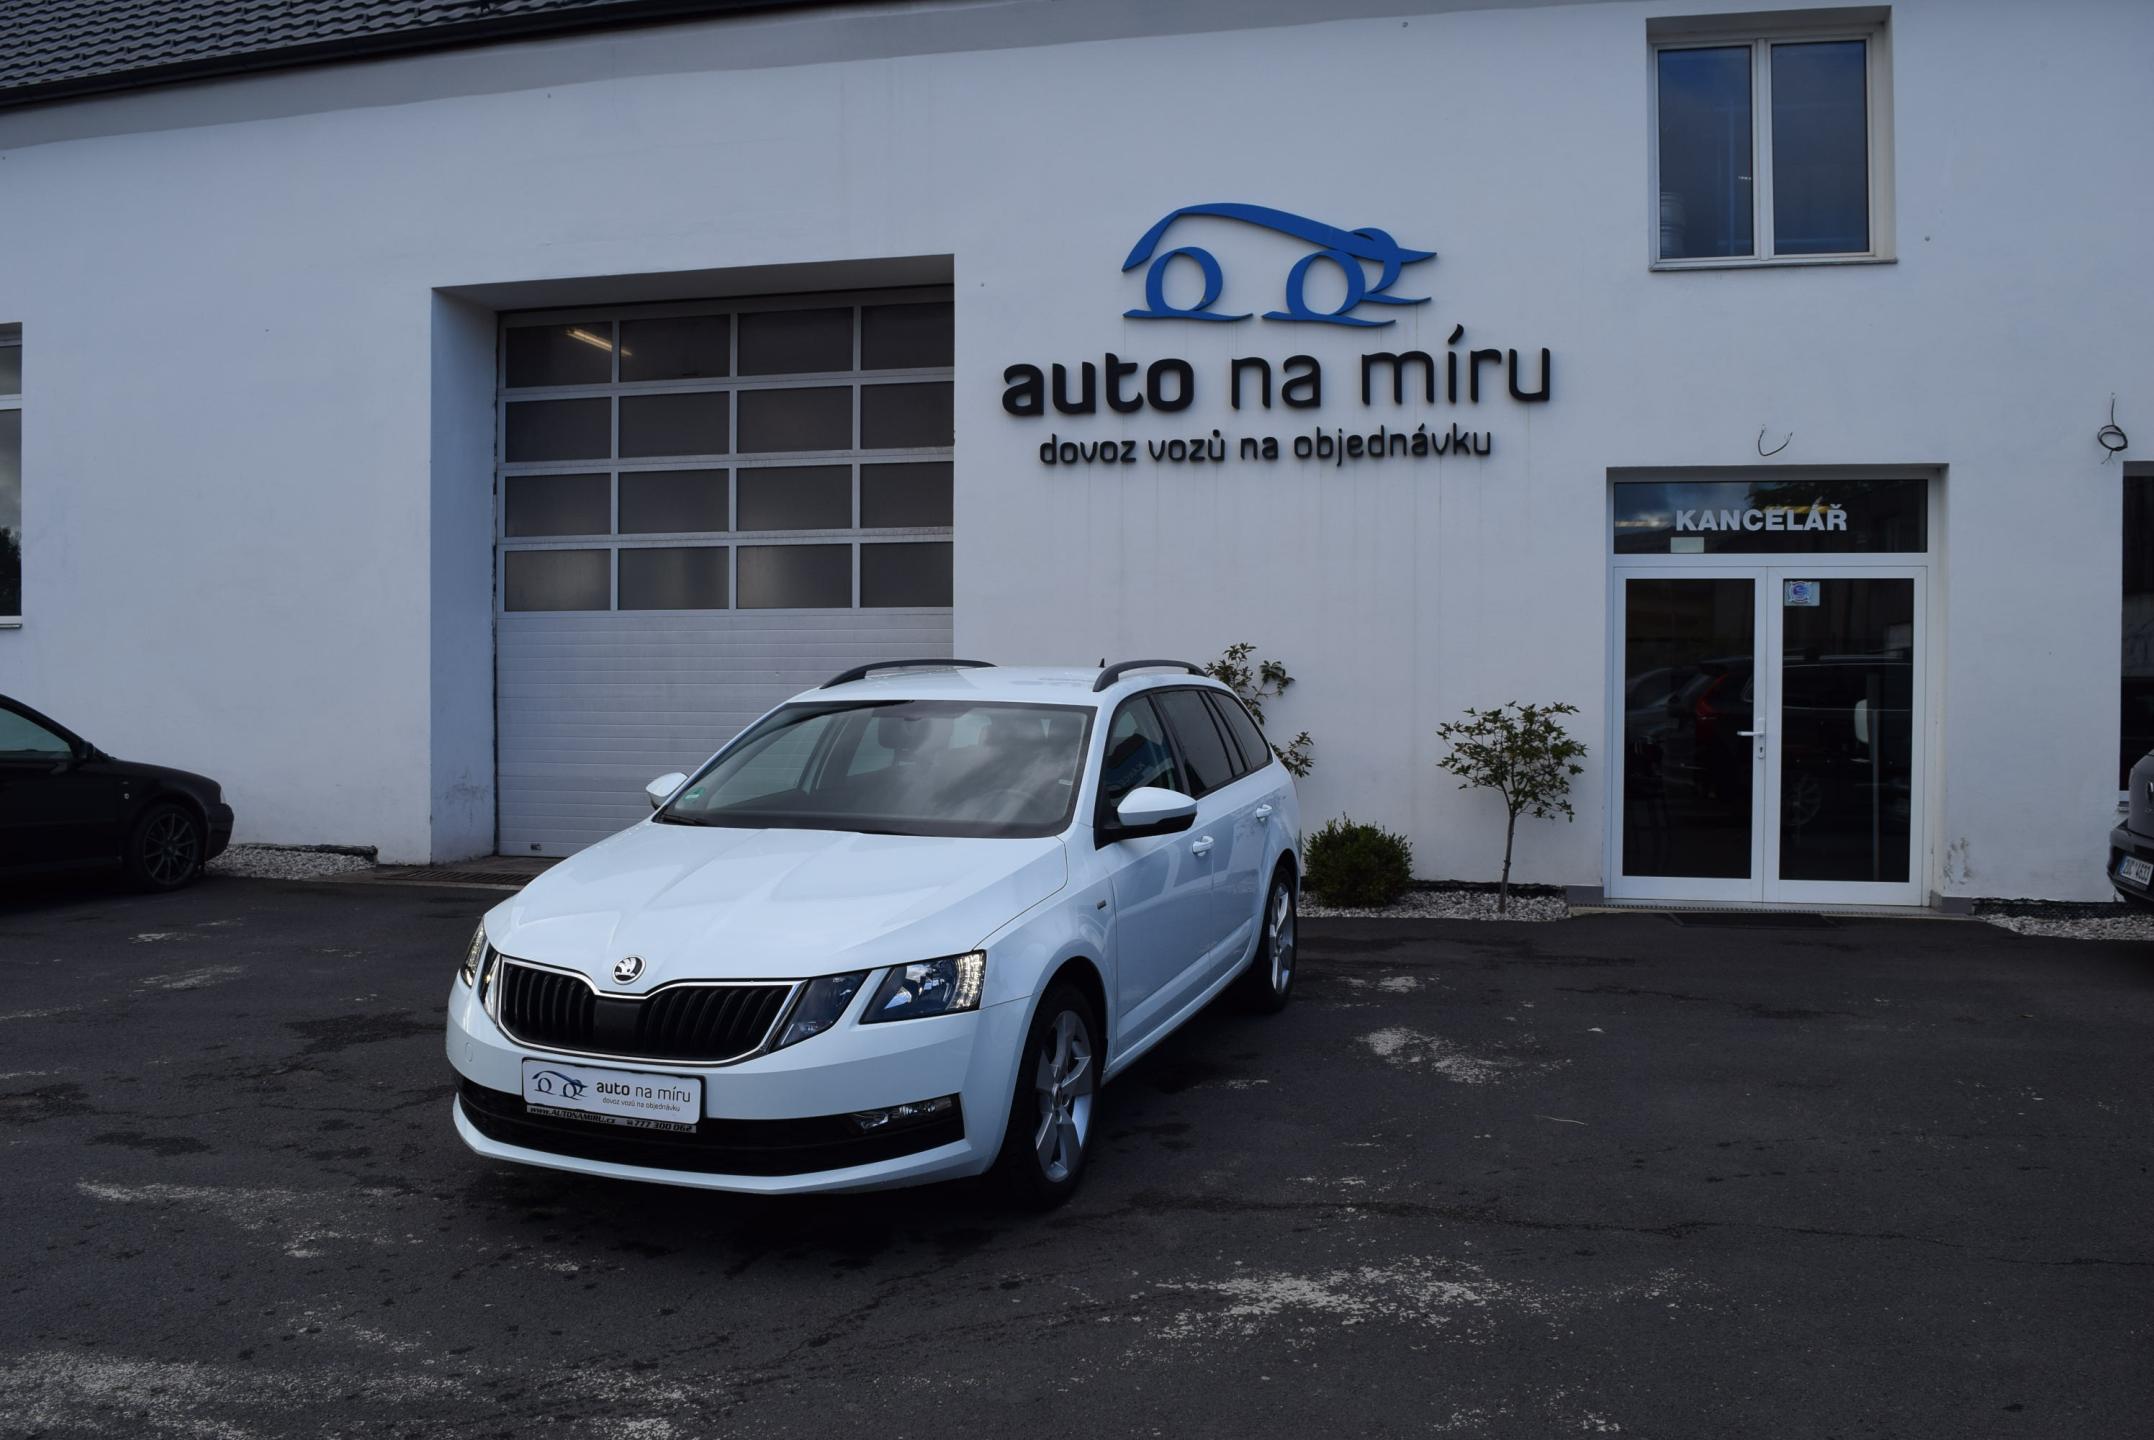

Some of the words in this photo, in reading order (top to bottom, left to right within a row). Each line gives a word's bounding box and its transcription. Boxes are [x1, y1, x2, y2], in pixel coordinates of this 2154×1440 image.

[1001, 352, 1195, 418] auto
[1231, 354, 1322, 411] na
[1361, 323, 1551, 407] míru
[1039, 433, 1137, 467] dovoz
[1147, 429, 1226, 464] vozů
[1240, 436, 1279, 462] na
[1293, 422, 1492, 468] objednávku
[1675, 503, 1848, 531] KANCELÁŘ
[596, 1081, 630, 1096] auto
[635, 1086, 653, 1099] na
[657, 1086, 691, 1103] míru
[602, 1097, 621, 1105] dovoz
[645, 1102, 681, 1112] objednávku
